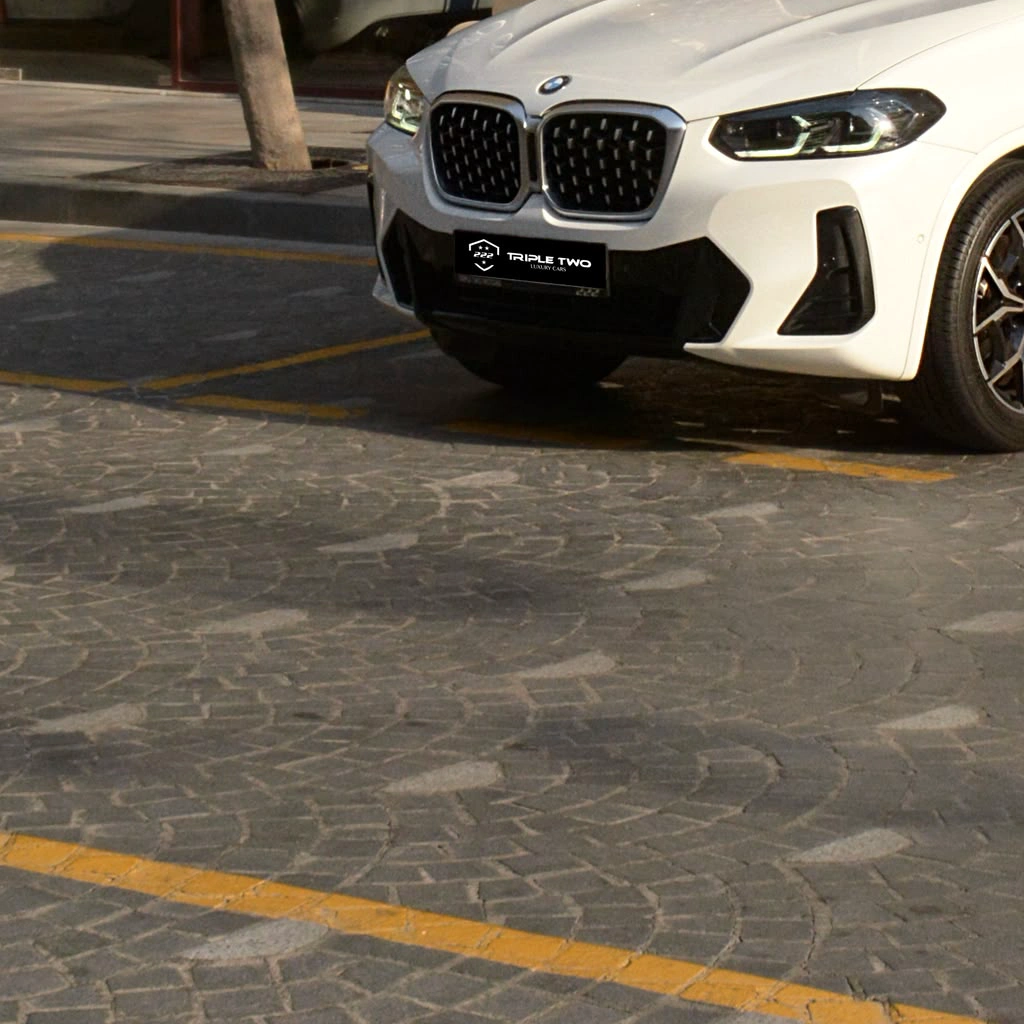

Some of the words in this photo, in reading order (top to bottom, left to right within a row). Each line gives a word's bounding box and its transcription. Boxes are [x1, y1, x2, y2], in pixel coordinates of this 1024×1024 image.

[473, 251, 494, 259] 222
[506, 251, 555, 265] TRIPLE
[557, 256, 592, 269] TWO
[530, 263, 552, 271] LUXURY
[552, 265, 567, 273] CARS
